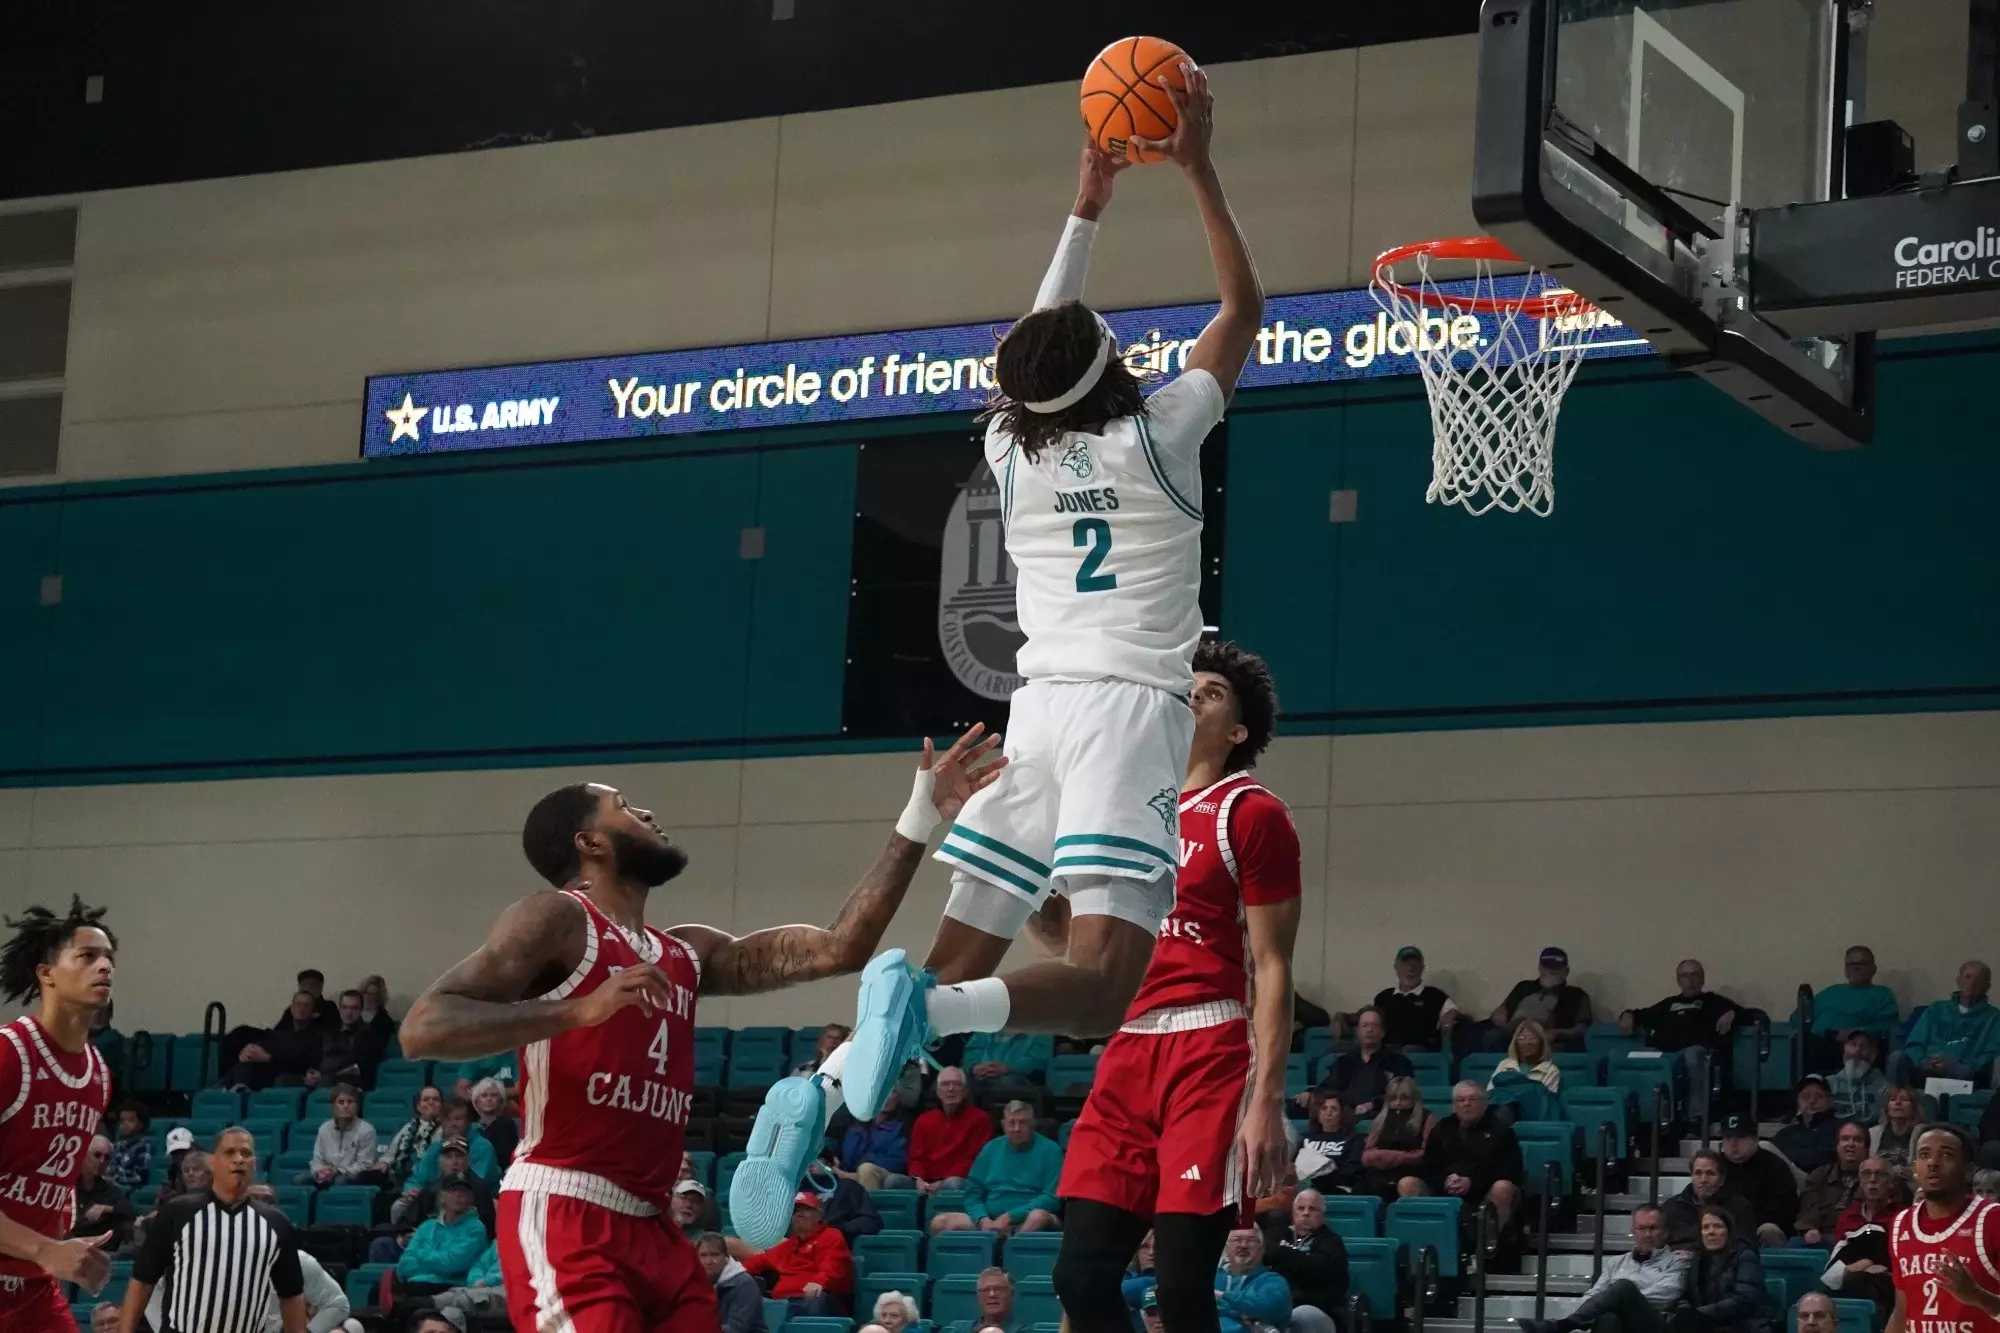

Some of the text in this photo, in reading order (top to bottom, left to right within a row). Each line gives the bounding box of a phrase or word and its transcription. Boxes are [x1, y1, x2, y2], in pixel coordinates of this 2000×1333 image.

[1896, 263, 1980, 289] FEDERAL
[609, 376, 701, 419] Your
[709, 362, 820, 412] circle
[830, 364, 875, 400] of
[1256, 320, 1332, 365] the
[1346, 308, 1487, 368] globe.
[432, 397, 560, 433] U.S. ARMY
[1054, 488, 1119, 514] JONES
[1073, 517, 1117, 592] 2
[648, 1018, 668, 1076] 4
[587, 1072, 693, 1126] CAJUNS
[36, 1133, 82, 1178] 23
[1899, 1253, 1971, 1278] RAG'
[1922, 1278, 1939, 1316] 2
